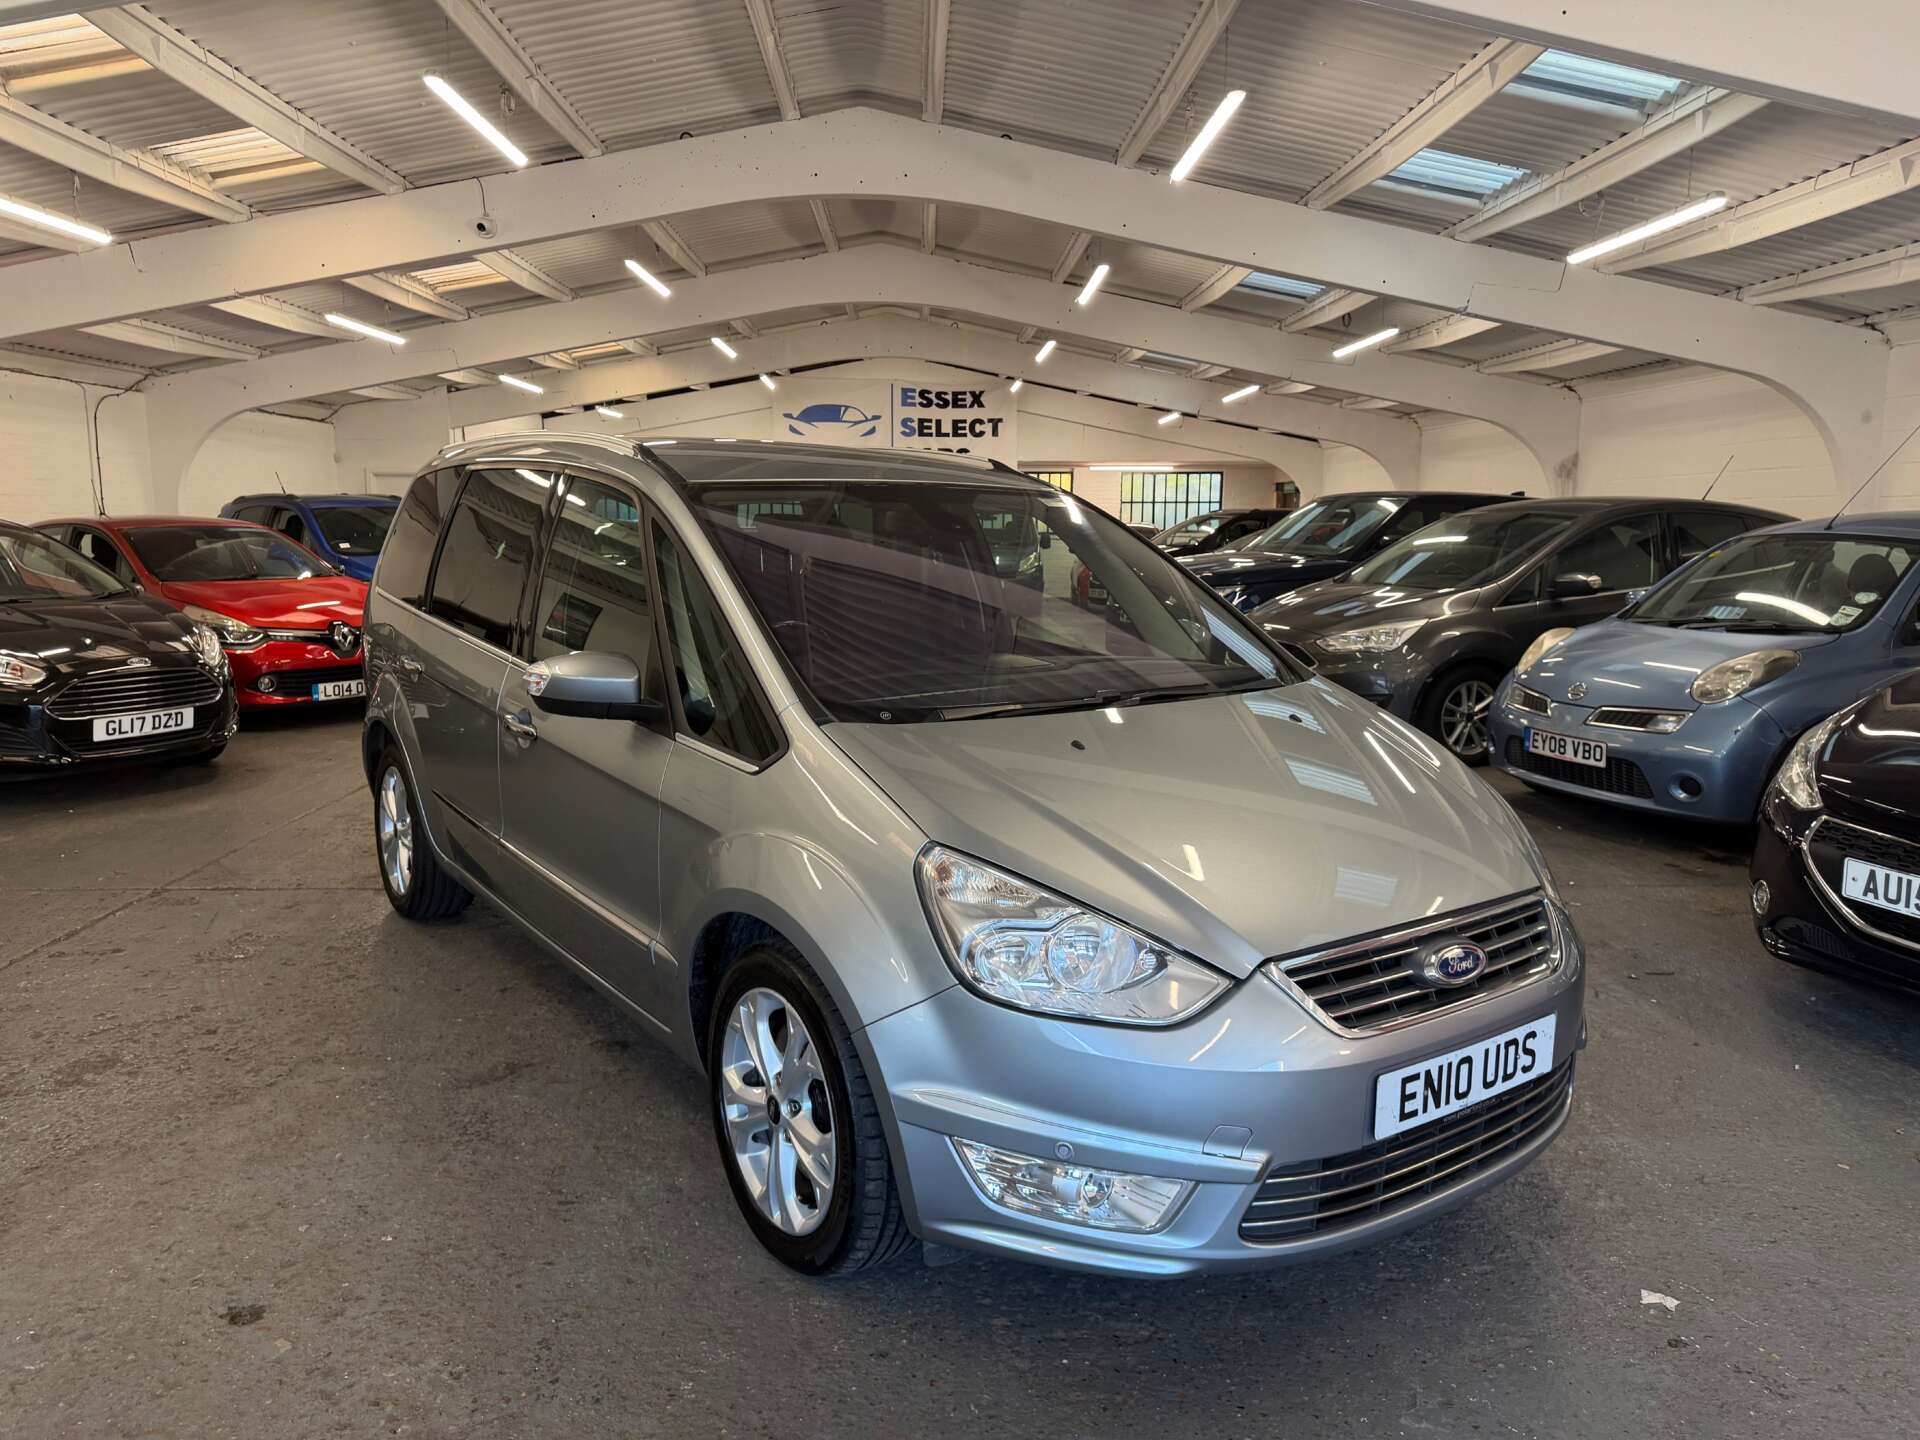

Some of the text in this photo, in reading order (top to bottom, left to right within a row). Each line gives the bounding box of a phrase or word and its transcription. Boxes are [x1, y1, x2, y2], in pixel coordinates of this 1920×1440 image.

[901, 388, 985, 409] ESSEX
[901, 417, 1003, 437] SELECT
[324, 683, 352, 697] LO14
[105, 711, 184, 736] GL17 DZD
[1532, 732, 1604, 762] EY08 VBO
[1445, 952, 1474, 974] Ford
[1399, 1030, 1538, 1122] EN10 UDS
